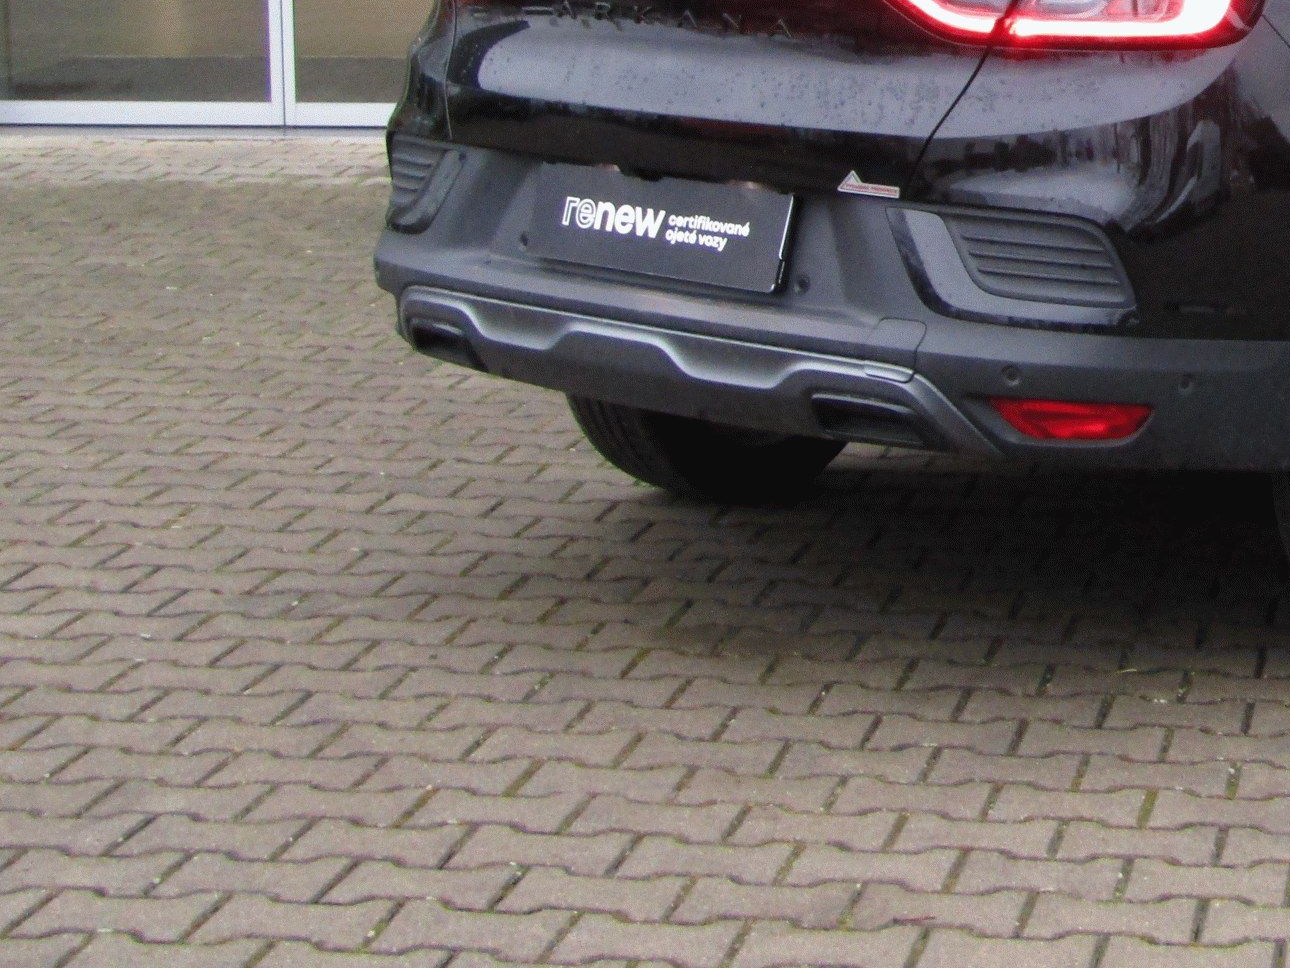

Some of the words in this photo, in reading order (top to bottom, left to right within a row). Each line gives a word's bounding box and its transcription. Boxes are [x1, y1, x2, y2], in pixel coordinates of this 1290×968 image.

[562, 196, 665, 238] renew
[668, 214, 750, 237] certifikované
[665, 228, 696, 245] ojeté
[699, 235, 728, 252] vozy
